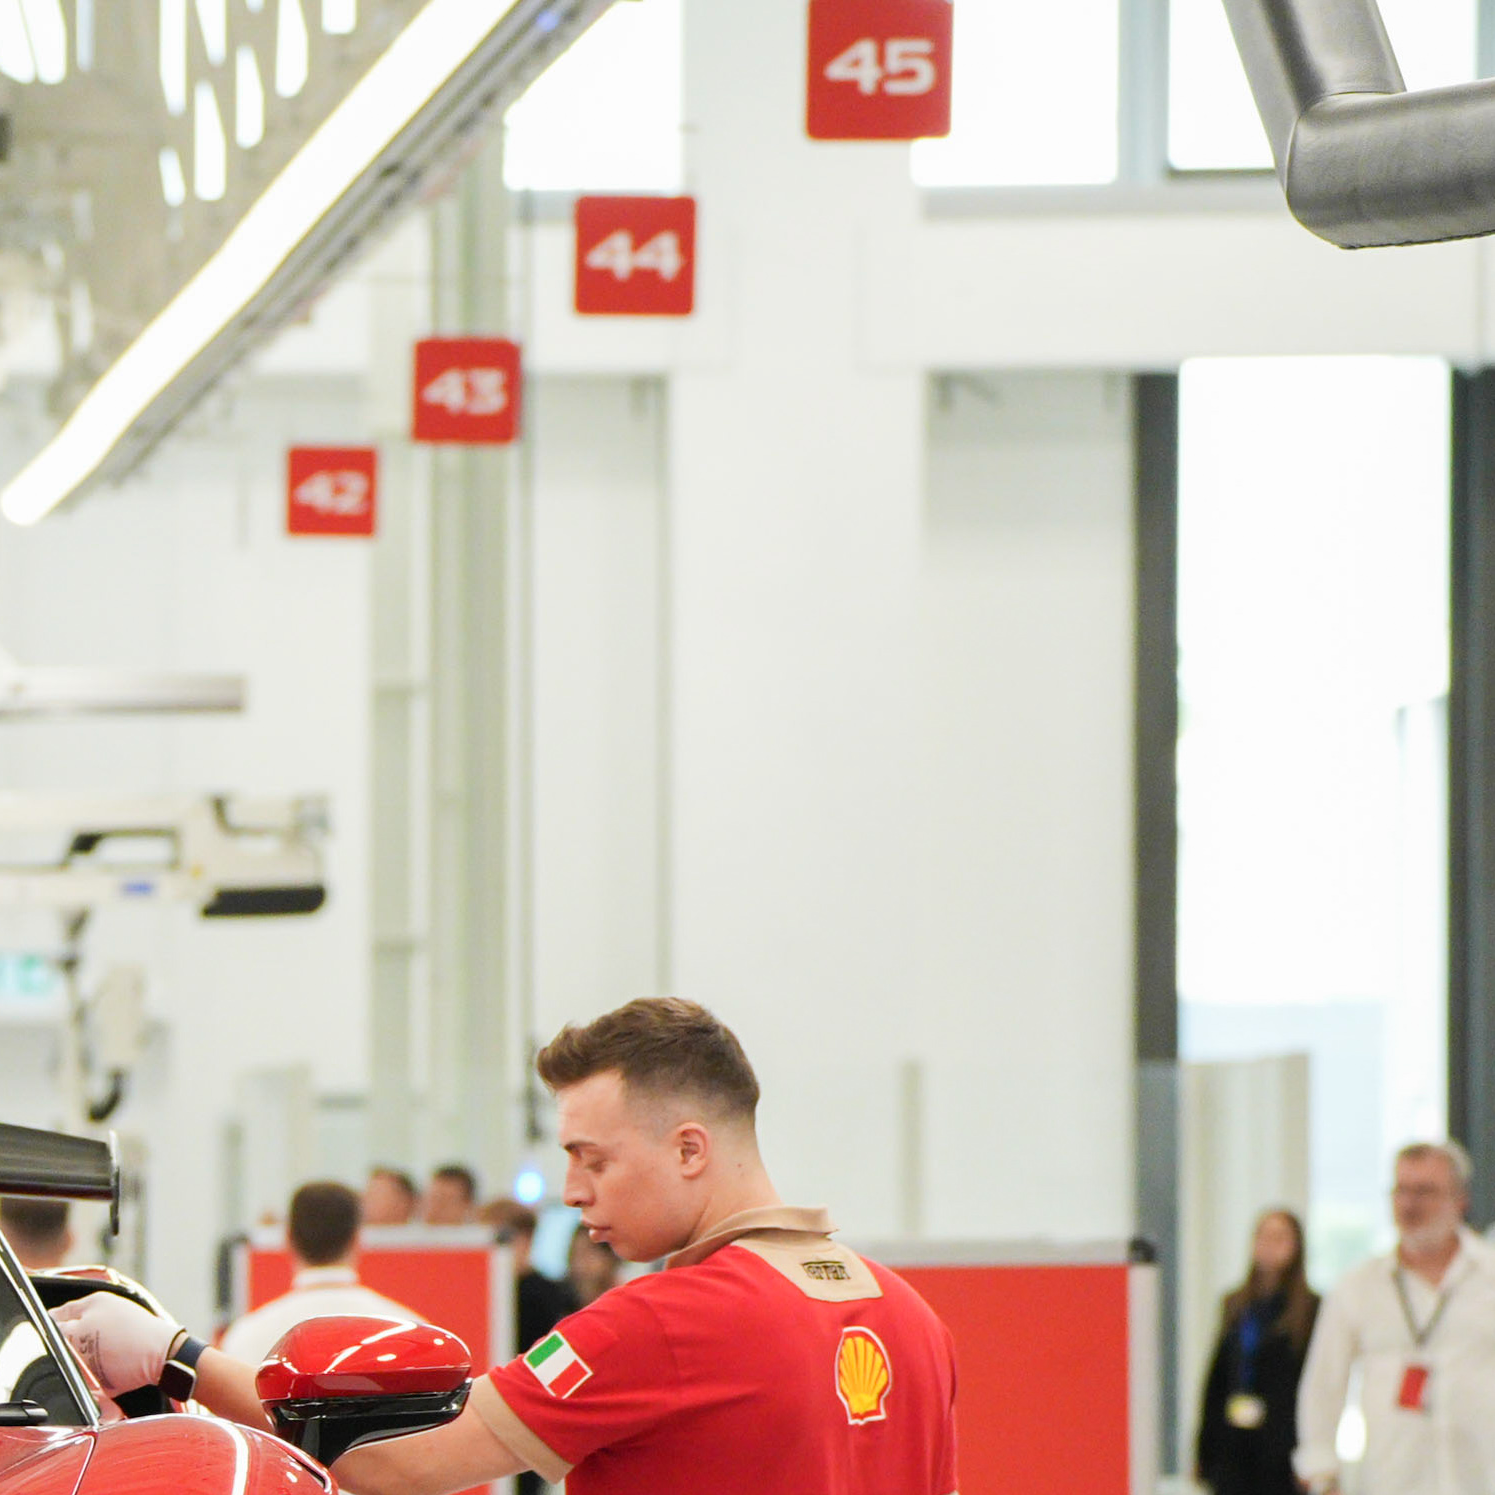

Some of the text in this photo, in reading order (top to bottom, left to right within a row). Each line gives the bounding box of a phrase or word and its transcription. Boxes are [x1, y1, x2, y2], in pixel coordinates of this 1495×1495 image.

[824, 38, 937, 96] 45
[585, 229, 682, 282] 44
[421, 366, 507, 417] 43
[294, 470, 369, 516] 42
